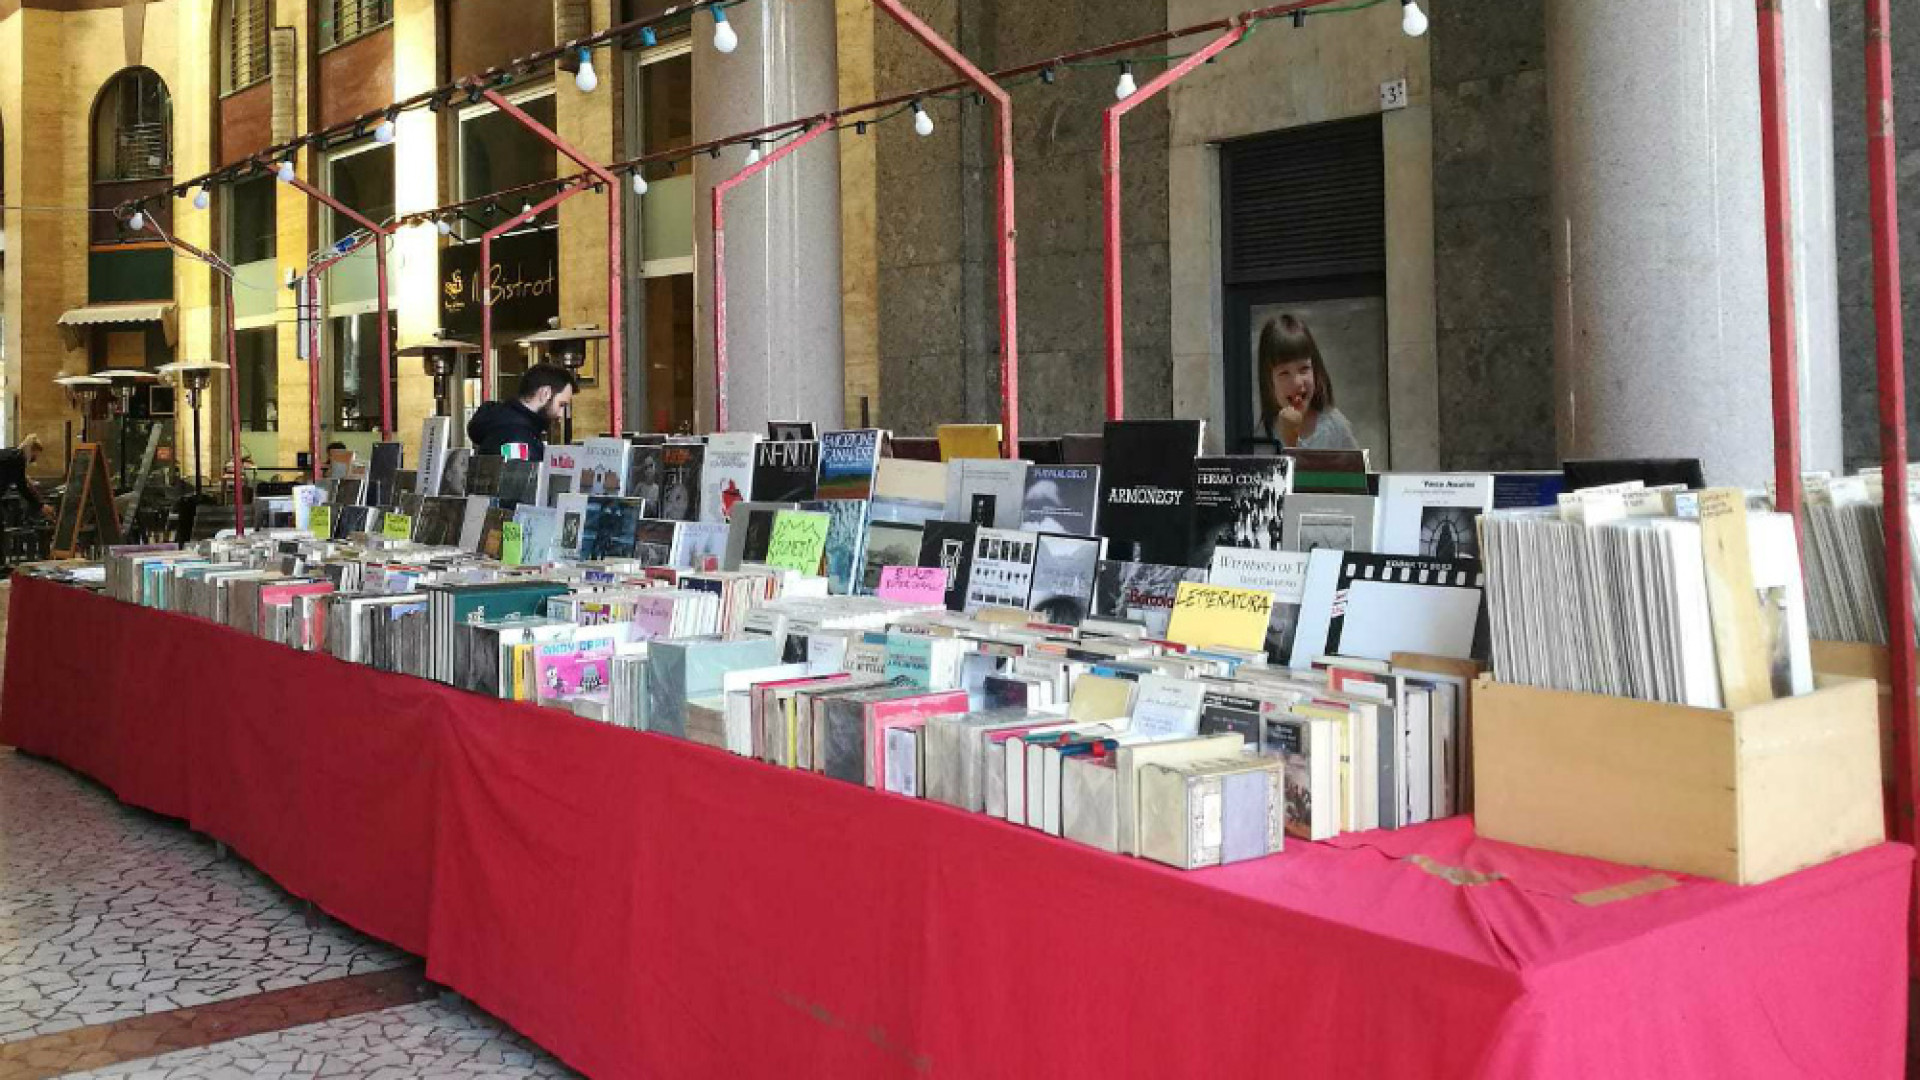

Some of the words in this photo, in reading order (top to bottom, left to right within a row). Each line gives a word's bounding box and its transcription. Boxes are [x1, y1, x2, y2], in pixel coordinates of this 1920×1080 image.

[489, 258, 555, 305] Bistrot
[1197, 473, 1233, 484] FERMO
[1107, 487, 1184, 505] ARMONEGY
[1178, 588, 1270, 615] LETTERATURA
